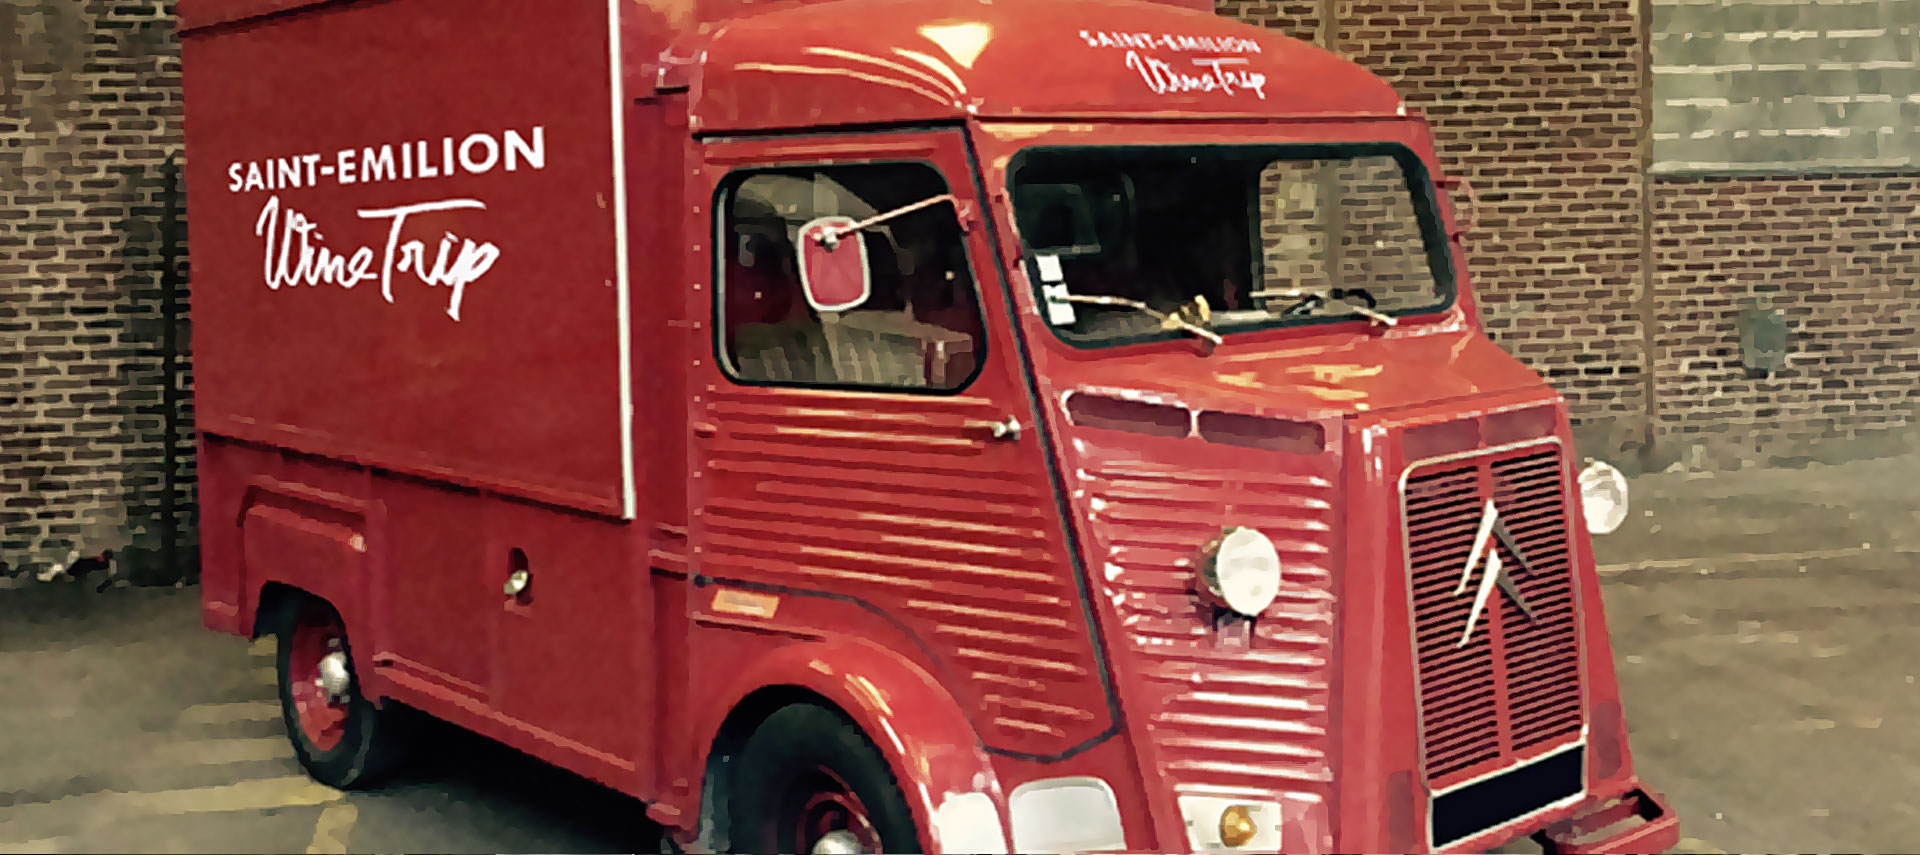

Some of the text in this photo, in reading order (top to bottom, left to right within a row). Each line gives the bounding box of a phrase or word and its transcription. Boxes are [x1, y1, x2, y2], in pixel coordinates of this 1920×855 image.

[228, 126, 545, 192] SAINT-EMILION
[256, 196, 500, 321] Wine Trip
